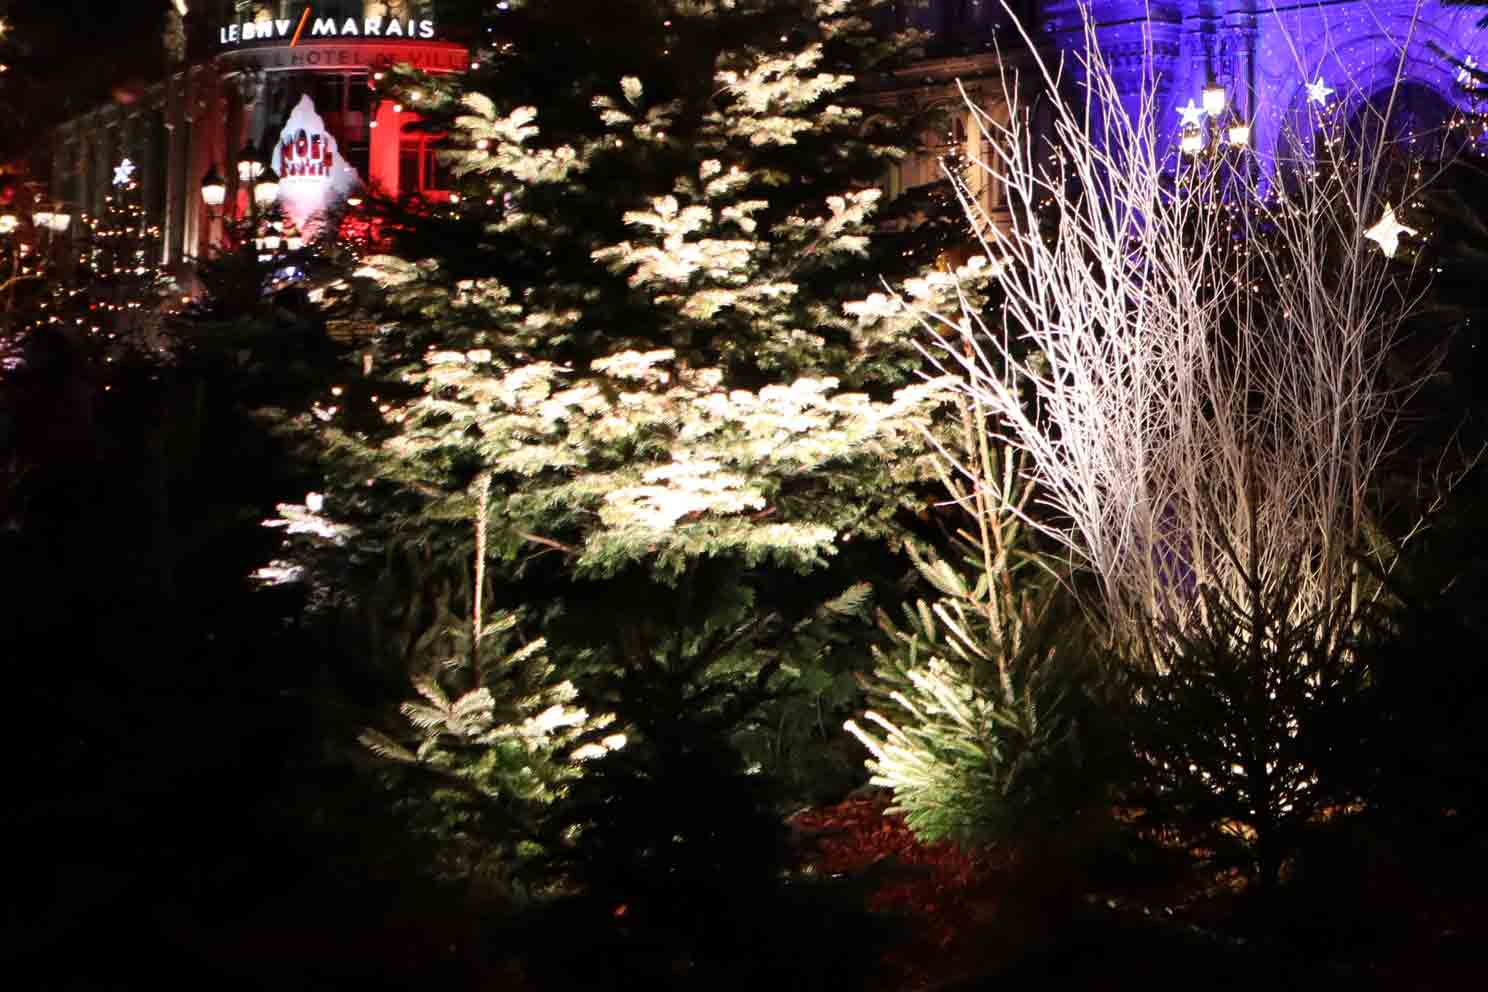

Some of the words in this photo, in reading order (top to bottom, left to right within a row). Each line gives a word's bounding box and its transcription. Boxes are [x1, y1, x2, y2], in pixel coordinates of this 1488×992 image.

[220, 24, 240, 44] LE
[241, 18, 291, 40] BHV
[311, 17, 436, 39] MARAIS
